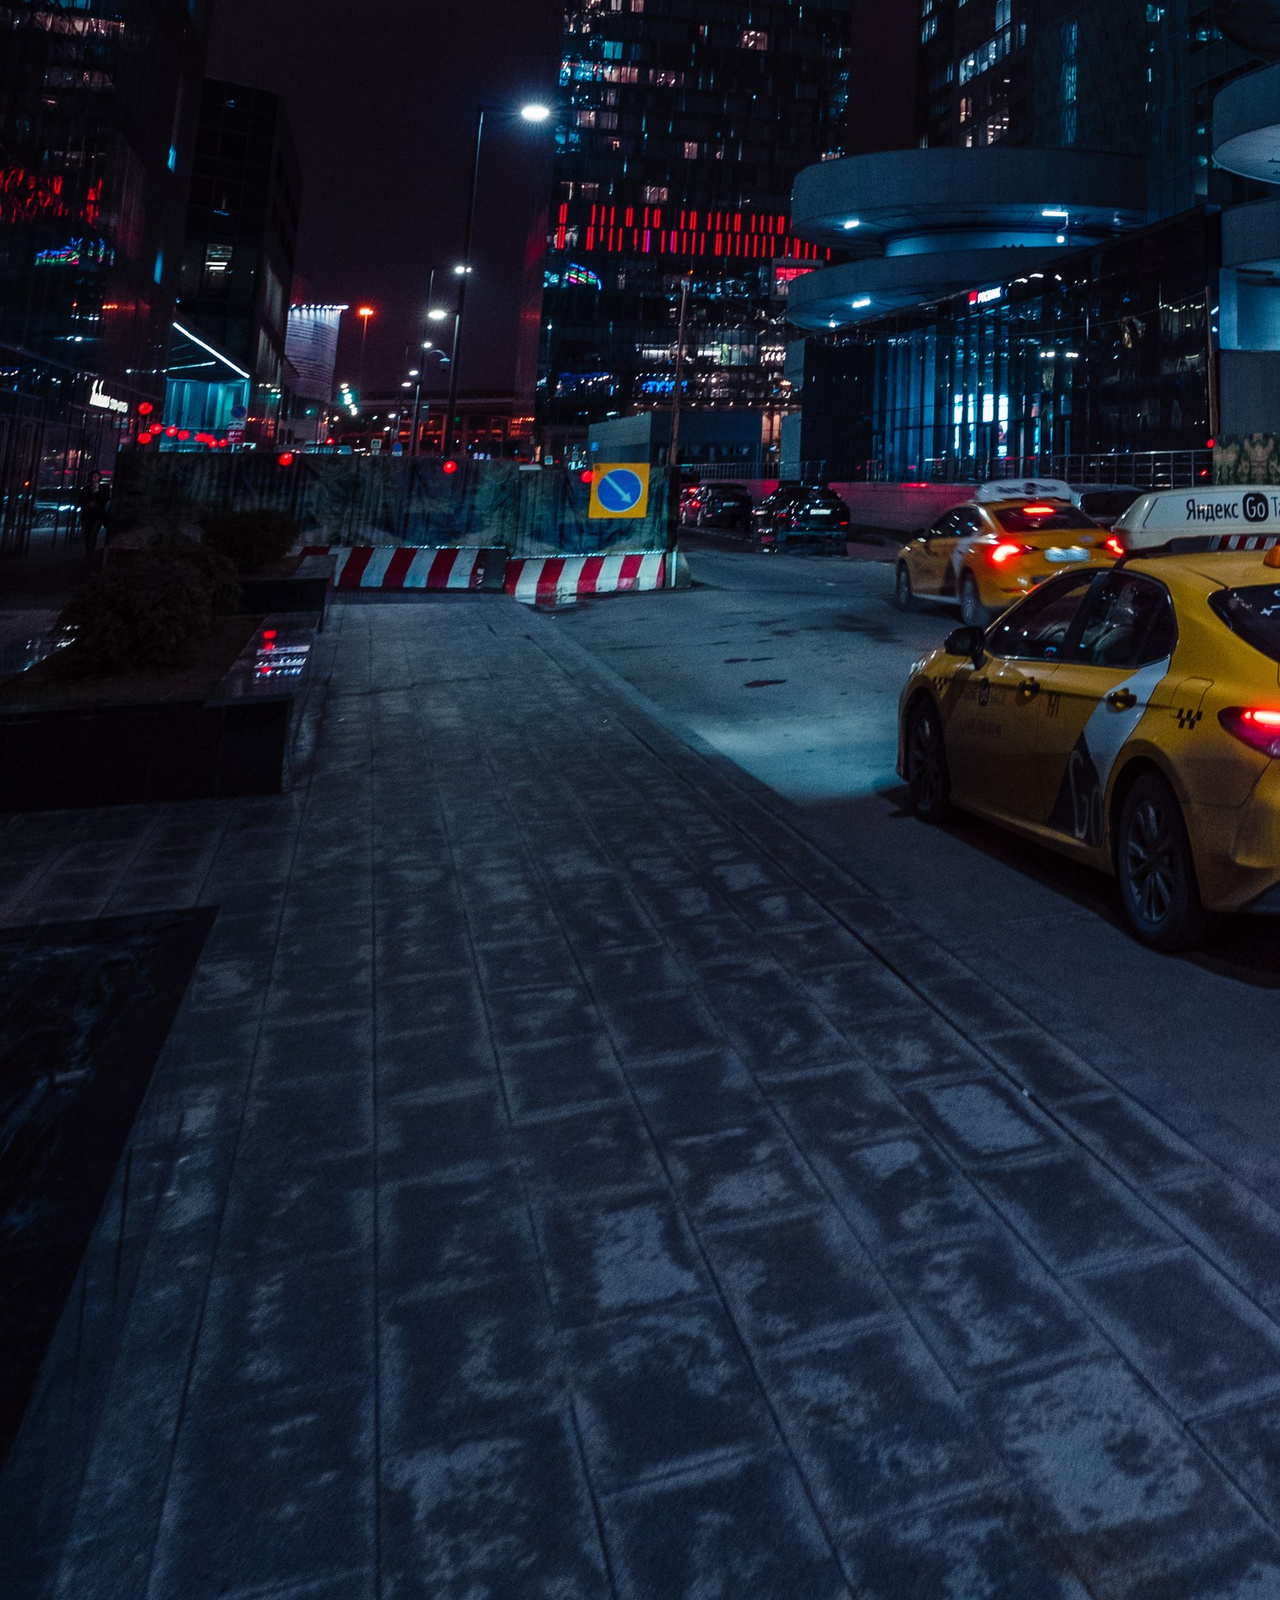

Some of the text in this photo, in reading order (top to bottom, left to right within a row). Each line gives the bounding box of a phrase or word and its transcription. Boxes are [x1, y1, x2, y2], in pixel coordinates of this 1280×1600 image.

[1186, 498, 1240, 522] Яндекс
[1245, 496, 1266, 518] Go
[1068, 750, 1103, 847] Go
